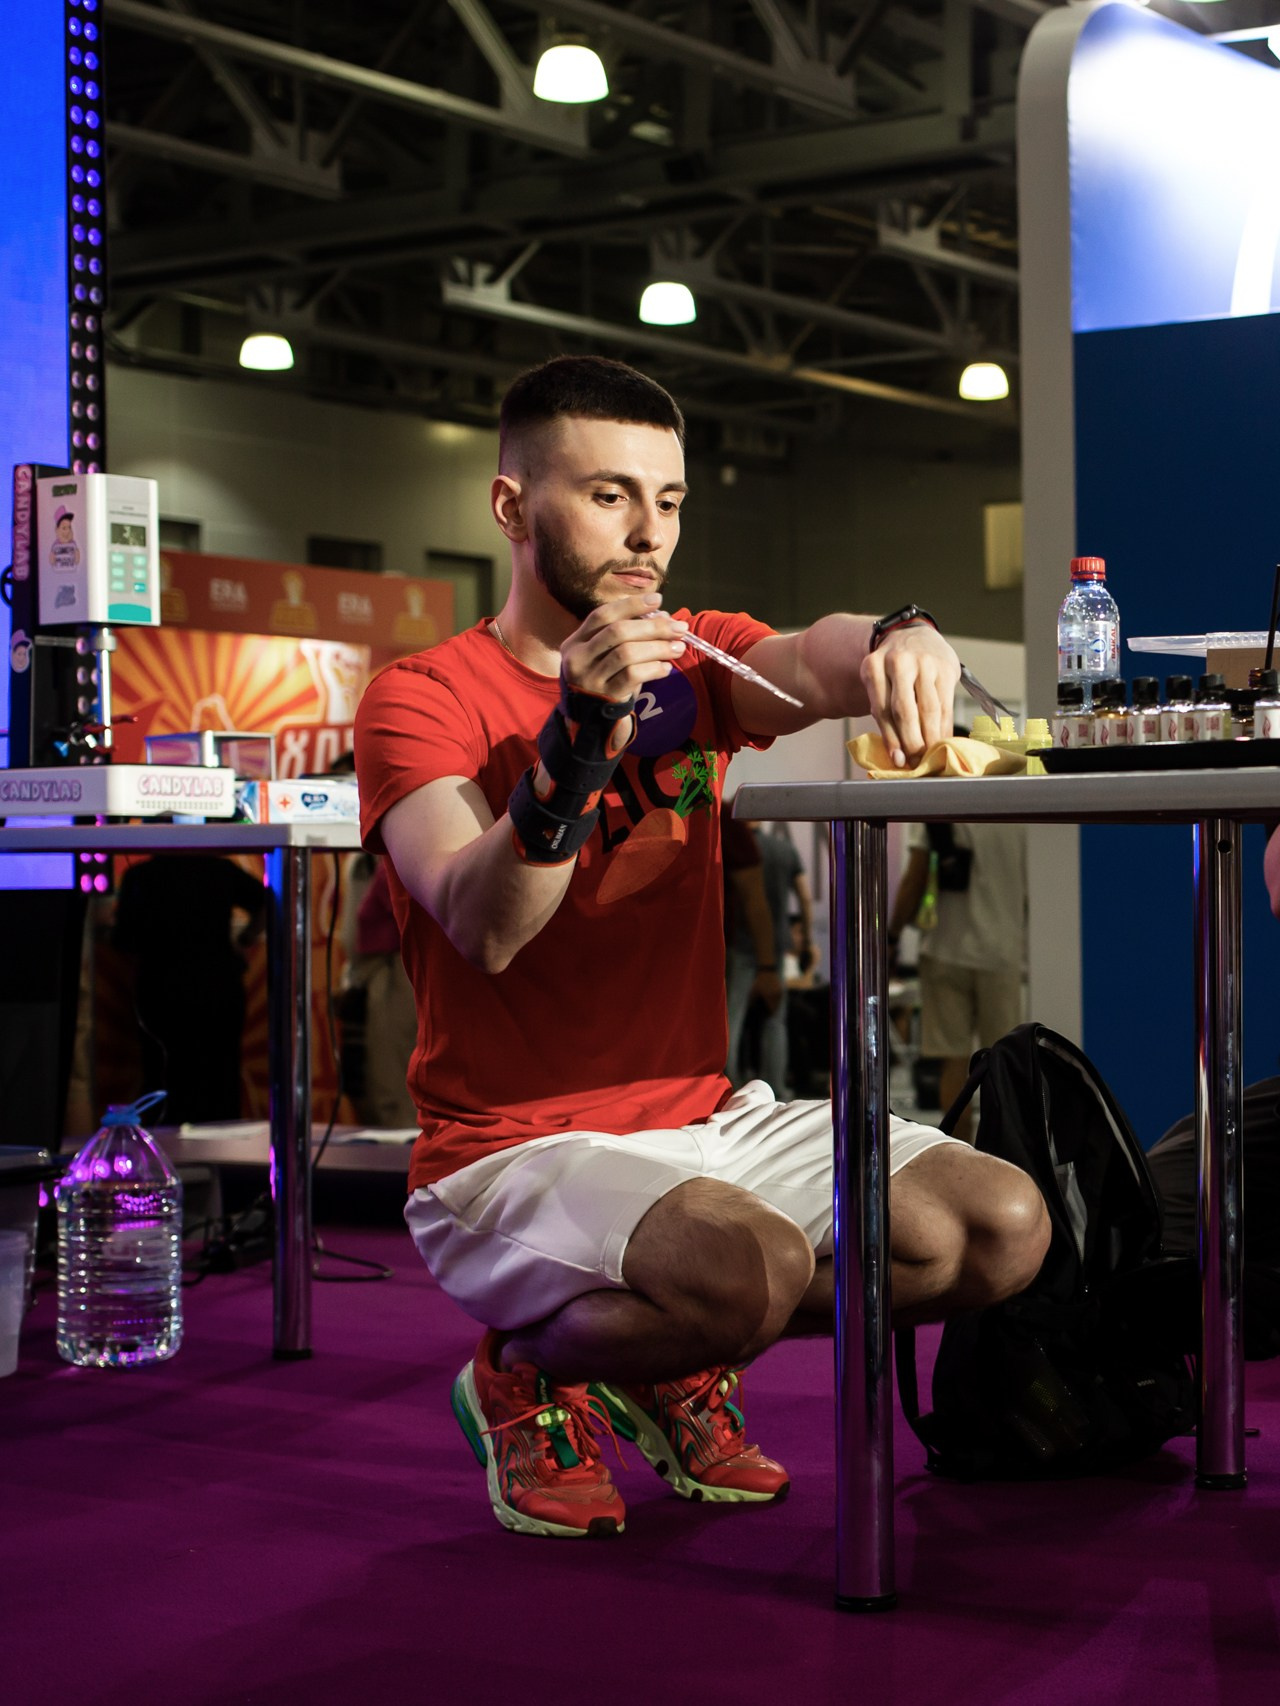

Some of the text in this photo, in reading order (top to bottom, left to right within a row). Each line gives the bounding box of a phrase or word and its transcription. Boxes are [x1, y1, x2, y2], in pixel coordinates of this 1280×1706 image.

[14, 465, 32, 581] CANDYLAB
[634, 691, 664, 721] 2
[0, 780, 82, 802] CANDYLAB
[138, 775, 224, 798] CANDYLAB
